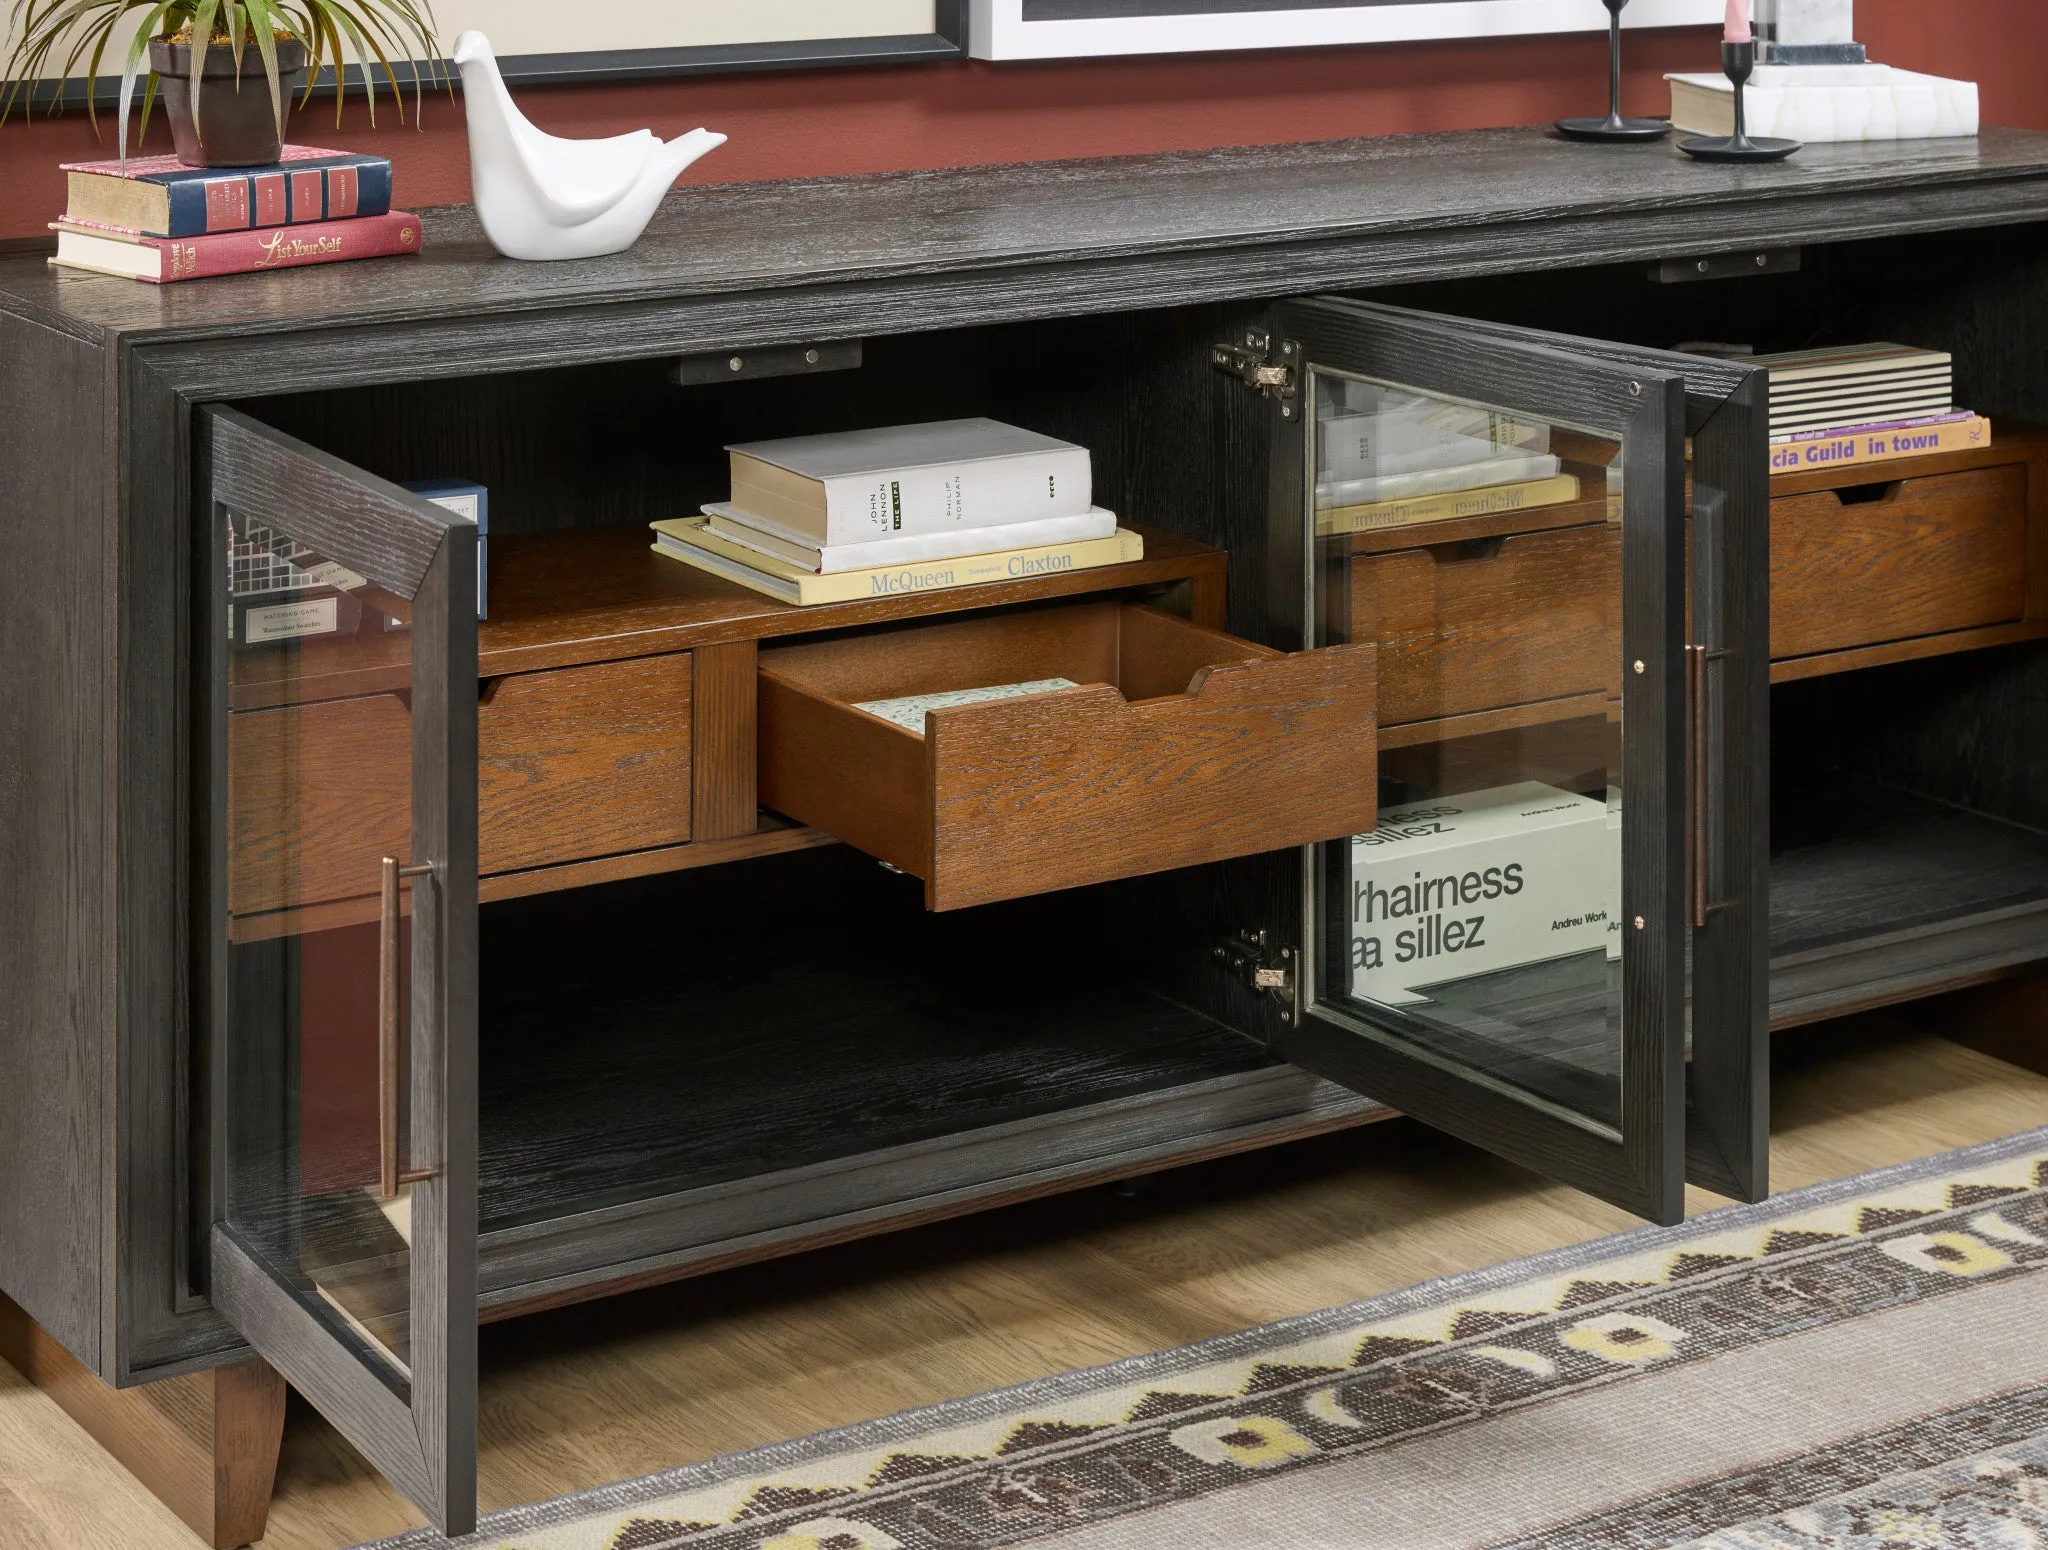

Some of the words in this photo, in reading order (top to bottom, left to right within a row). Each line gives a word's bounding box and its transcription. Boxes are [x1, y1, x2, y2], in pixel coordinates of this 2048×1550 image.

[254, 230, 292, 267] List
[291, 239, 319, 257] Your
[319, 236, 342, 253] Self
[1771, 449, 1799, 467] cia
[1805, 440, 1855, 463] Guild
[1868, 437, 1885, 455] in
[1892, 433, 1939, 452] town
[879, 484, 888, 532] LENNON
[892, 482, 900, 505] LIFE
[954, 476, 962, 520] NORMAN
[893, 510, 901, 529] THE
[871, 570, 955, 595] McQueen
[1007, 554, 1073, 577] Claxton
[263, 611, 298, 620] MATCHING
[300, 608, 319, 616] GAME
[1394, 914, 1486, 963] sillez
[1551, 917, 1583, 931] Andreu
